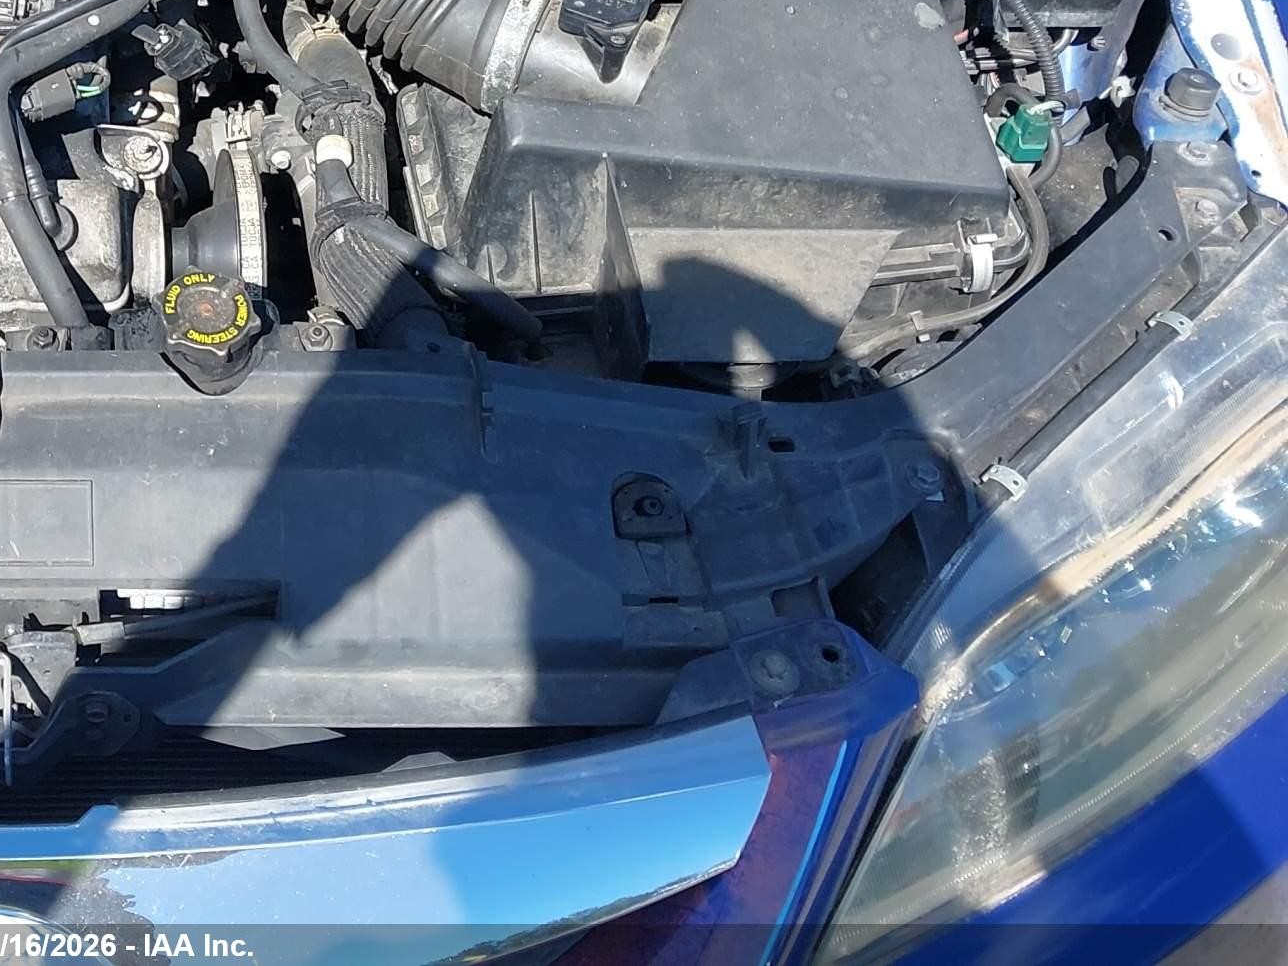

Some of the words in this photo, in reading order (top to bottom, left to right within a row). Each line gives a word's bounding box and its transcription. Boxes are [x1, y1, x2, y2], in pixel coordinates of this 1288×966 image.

[183, 273, 216, 286] ONLY
[164, 284, 182, 315] FLUID
[233, 293, 248, 327] POWER
[186, 326, 239, 345] STEERING
